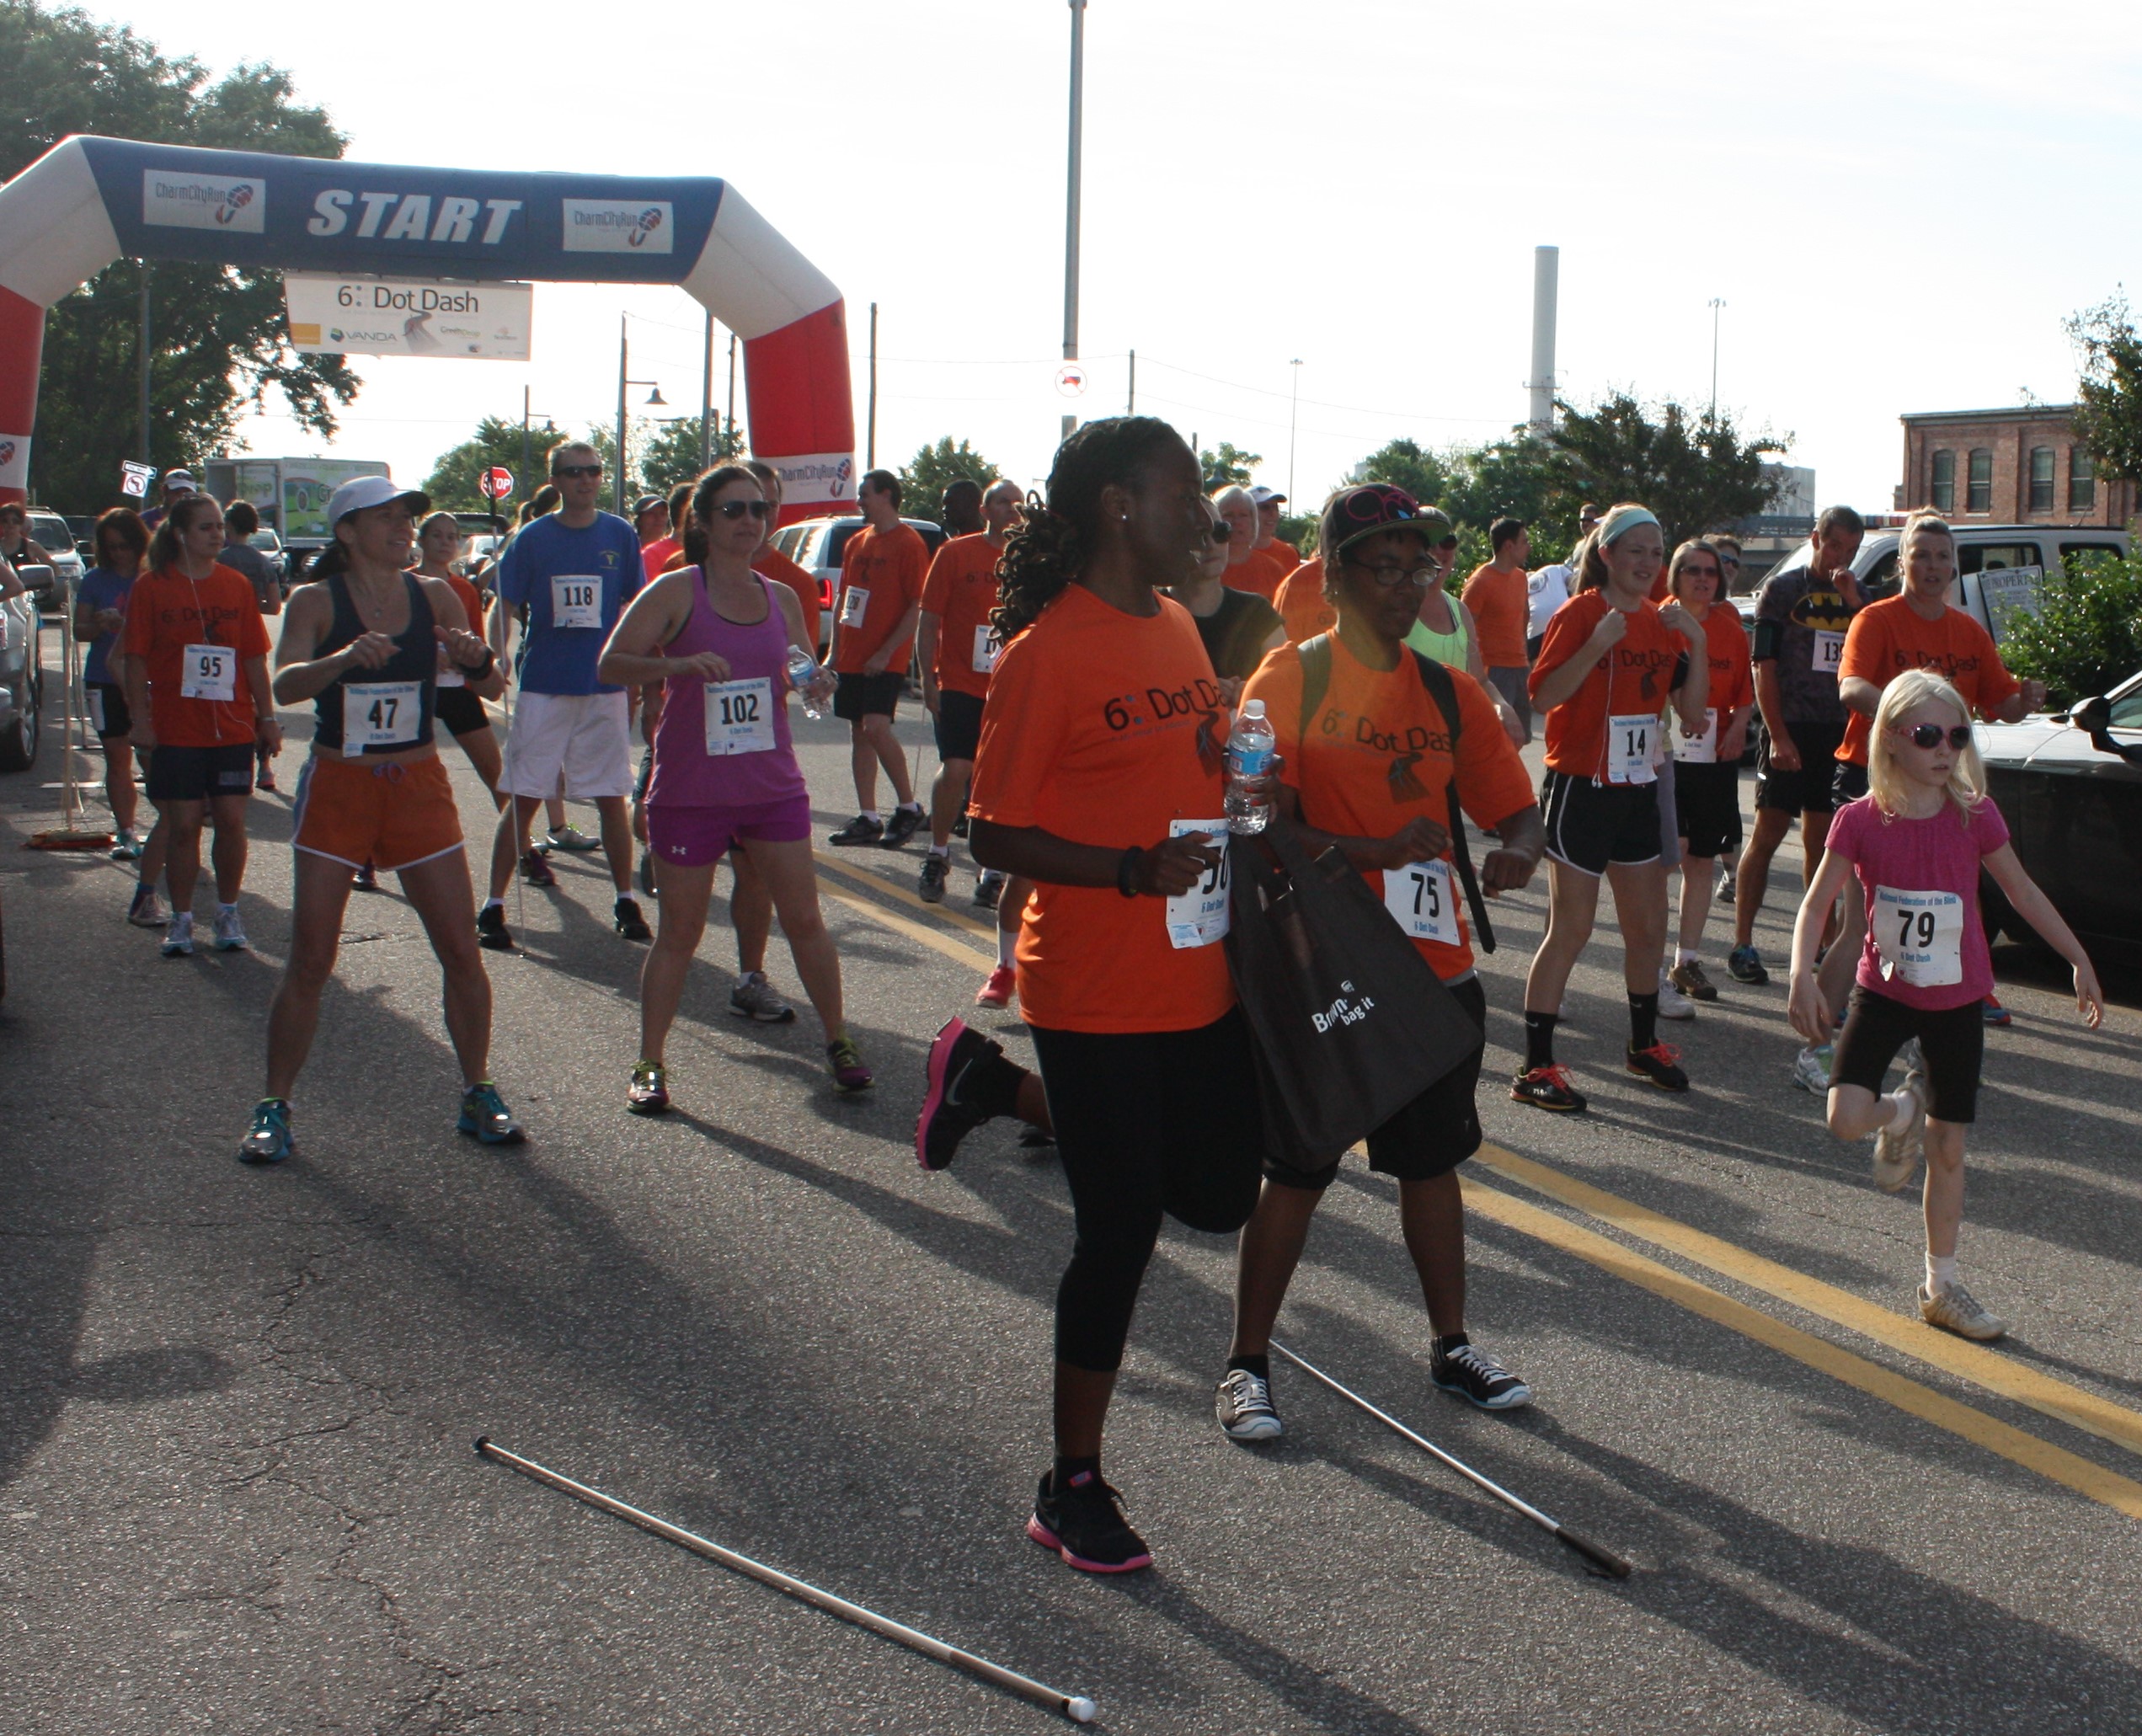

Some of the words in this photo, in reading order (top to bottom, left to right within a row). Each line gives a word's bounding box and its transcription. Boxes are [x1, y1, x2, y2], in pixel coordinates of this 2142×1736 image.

[155, 182, 226, 204] CharmCityRun
[307, 189, 524, 245] START
[574, 211, 638, 228] CharmCityRun
[374, 286, 416, 311] Dot
[422, 289, 478, 312] Dash
[346, 331, 398, 342] VANDA
[564, 585, 593, 606] 118
[200, 656, 222, 677] 95
[369, 698, 398, 729] 47
[720, 694, 760, 724] 102
[1146, 685, 1193, 719] Dot
[1356, 716, 1397, 752] Dot
[1627, 729, 1646, 756] 14
[1410, 872, 1440, 918] 75
[1898, 909, 1935, 948] 79
[1340, 1005, 1365, 1026] bag
[1360, 996, 1375, 1010] it
